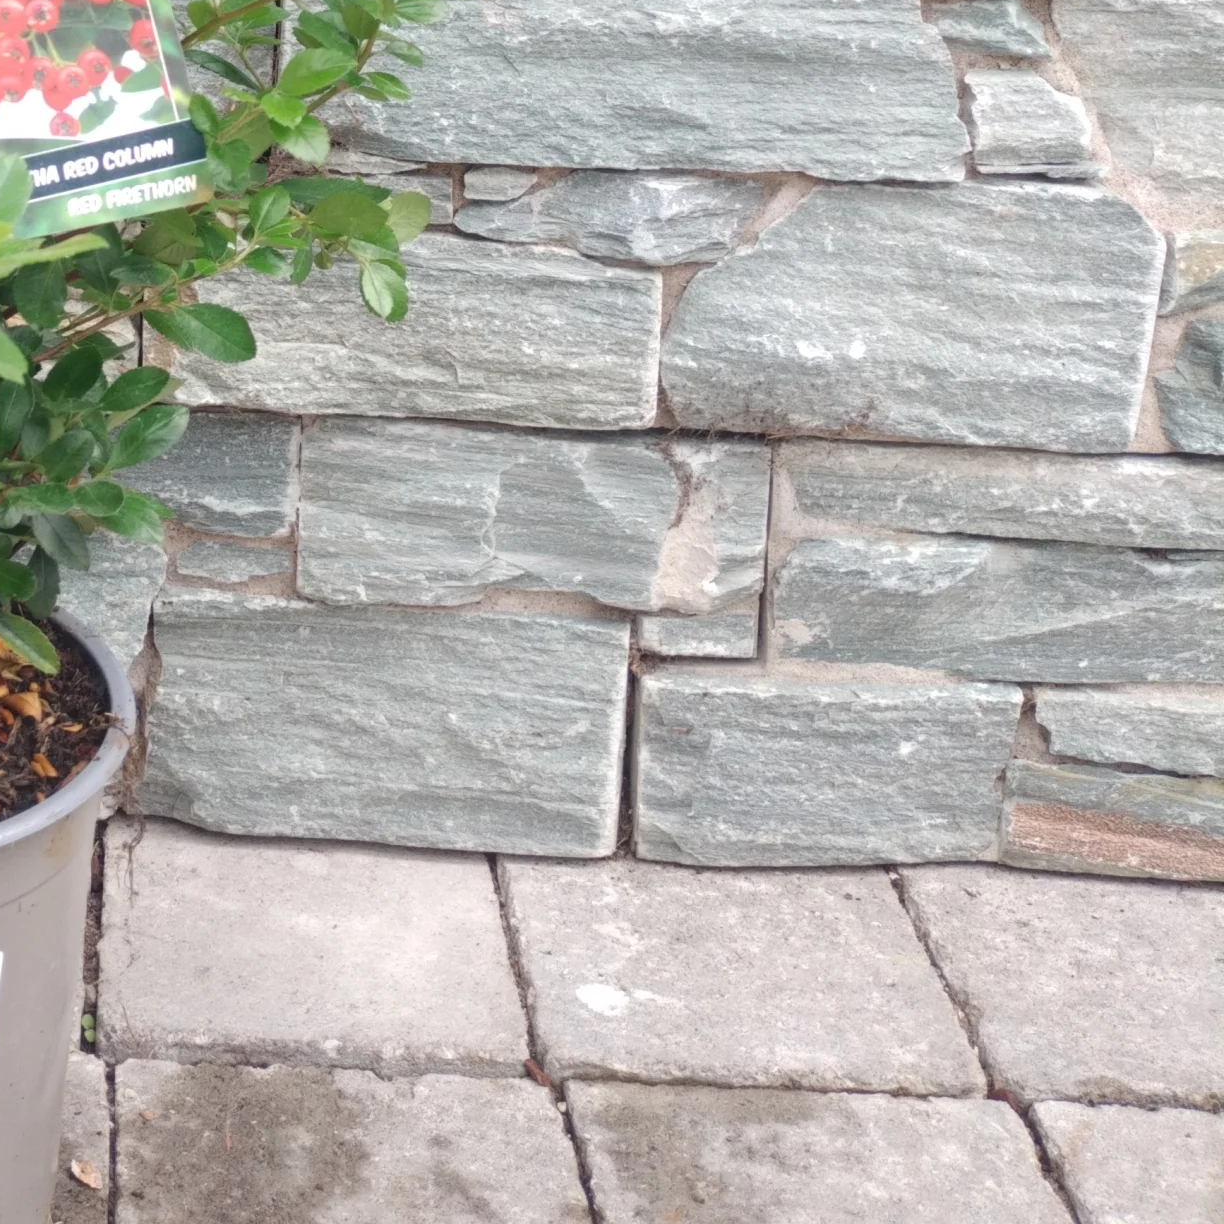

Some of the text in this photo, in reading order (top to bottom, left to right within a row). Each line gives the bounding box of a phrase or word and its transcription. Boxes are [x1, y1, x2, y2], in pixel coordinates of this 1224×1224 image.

[63, 156, 99, 180] RED
[102, 137, 174, 171] COLUMN
[67, 174, 197, 217] RED FIRETHORN
